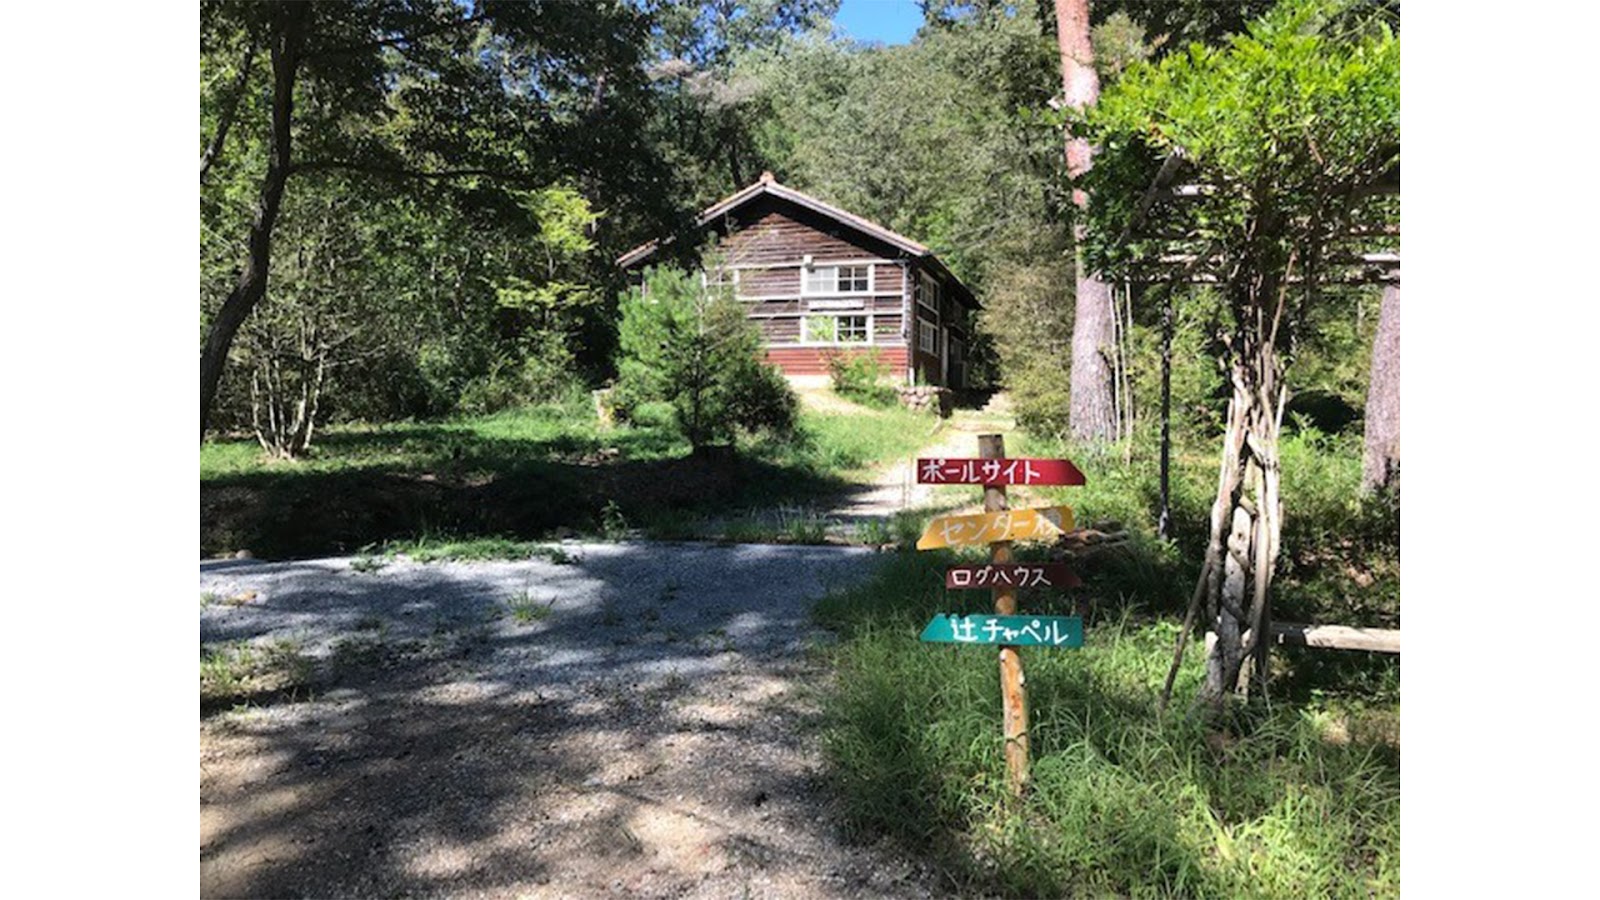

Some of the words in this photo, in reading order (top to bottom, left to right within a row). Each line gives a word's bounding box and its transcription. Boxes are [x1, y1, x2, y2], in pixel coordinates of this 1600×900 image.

[922, 459, 1041, 484] ポールサイト
[951, 565, 1052, 587] ログハウス
